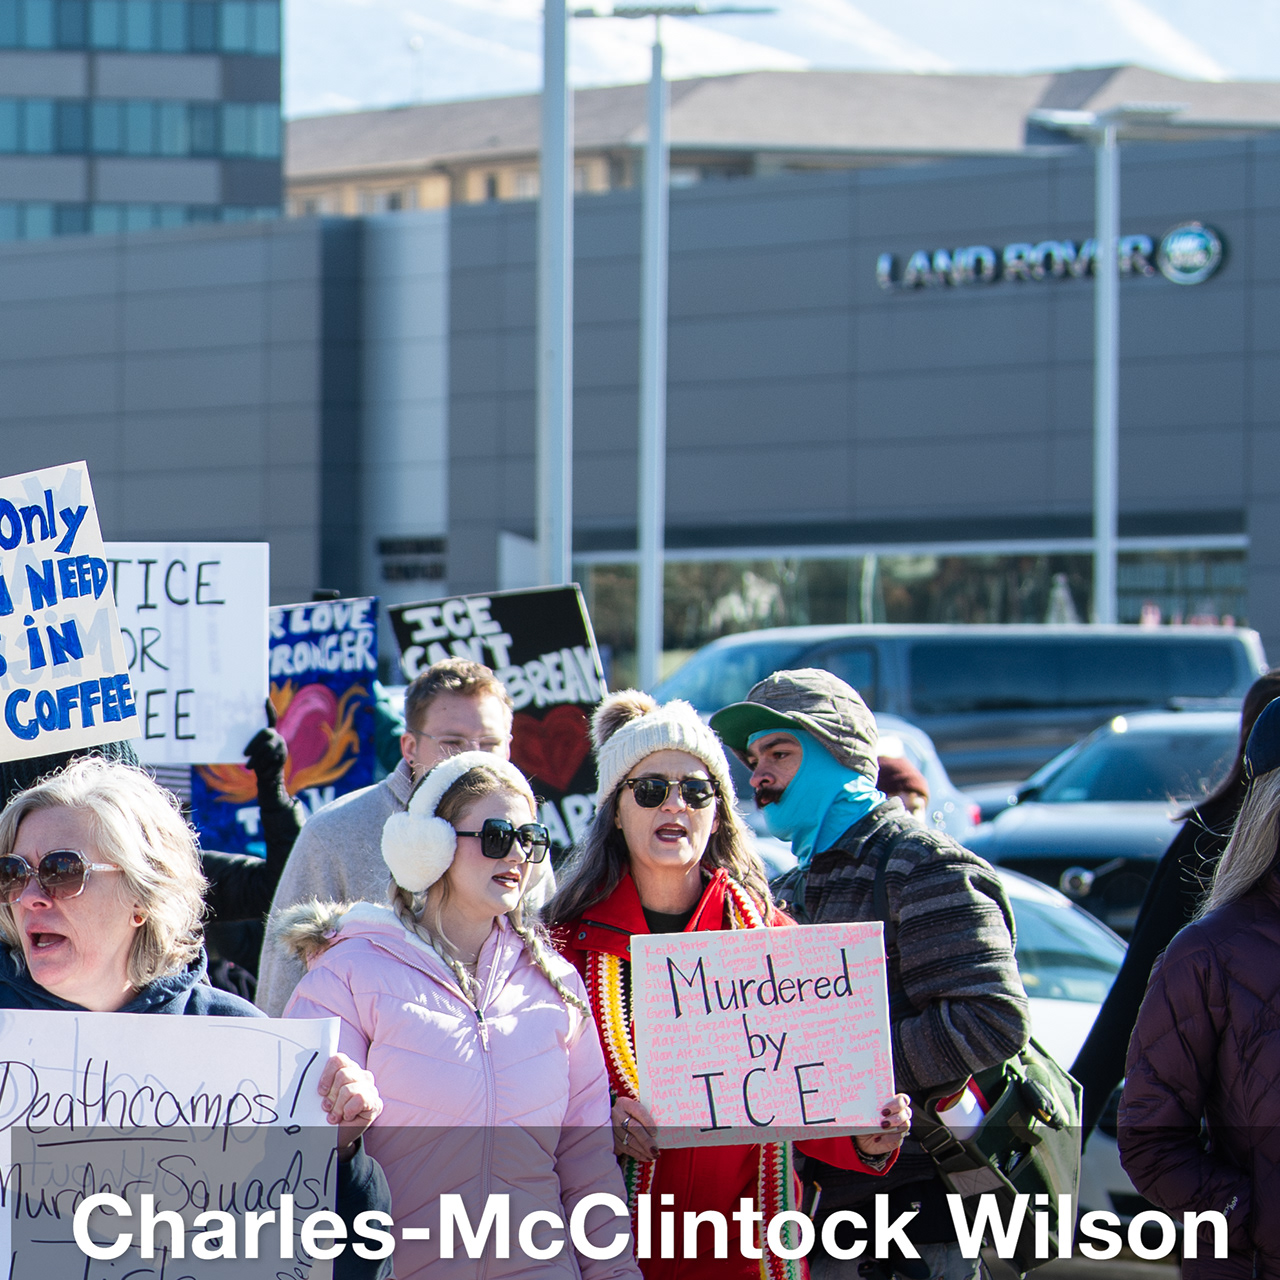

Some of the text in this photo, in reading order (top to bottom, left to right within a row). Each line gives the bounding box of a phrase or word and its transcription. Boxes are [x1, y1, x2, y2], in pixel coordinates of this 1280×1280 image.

[876, 245, 997, 291] LAND
[1003, 234, 1155, 284] ROVR
[26, 555, 108, 613] NEED
[111, 558, 225, 613] TICE
[290, 600, 375, 634] LOVE
[401, 597, 503, 645] ICE
[127, 626, 169, 672] OR
[494, 645, 605, 711] BREAK
[4, 673, 137, 741] COFFEE
[645, 944, 679, 957] Keith
[666, 948, 853, 1019] Murdered
[742, 1013, 787, 1071] by
[692, 1062, 836, 1132] ICE
